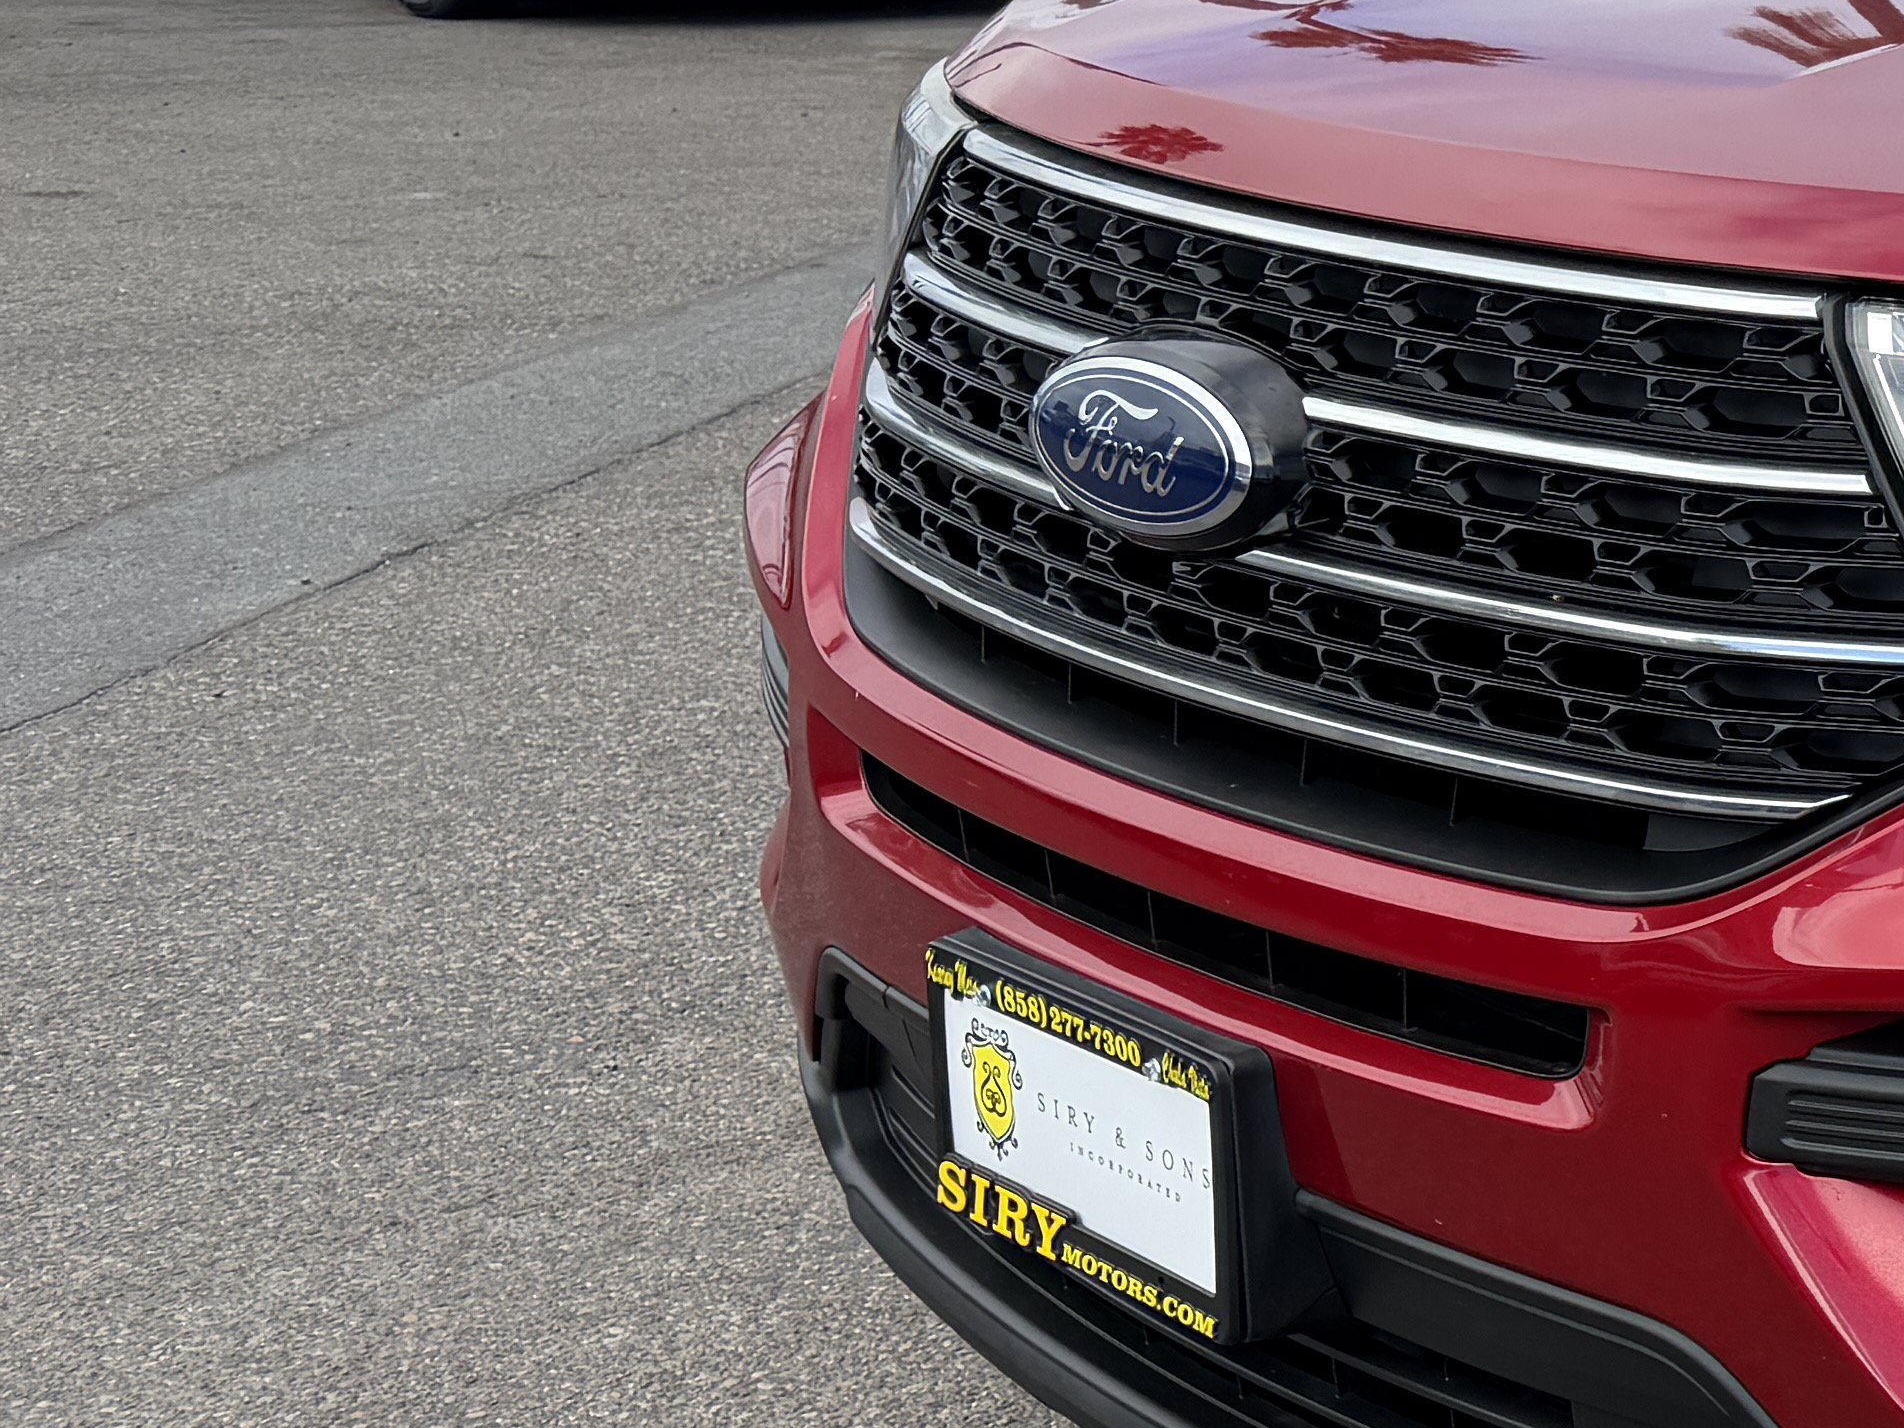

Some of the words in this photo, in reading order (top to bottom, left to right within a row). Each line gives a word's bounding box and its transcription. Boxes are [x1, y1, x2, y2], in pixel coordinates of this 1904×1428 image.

[1064, 389, 1184, 497] Ford
[995, 979, 1047, 1028] (858)
[1037, 1092, 1095, 1134] SIRY
[1115, 1127, 1126, 1149] &
[1145, 1140, 1211, 1189] SONS
[1070, 1142, 1181, 1202] INCORPORATED
[937, 1160, 1069, 1261] SIRY
[1061, 1242, 1217, 1339] MOTORS.COM
